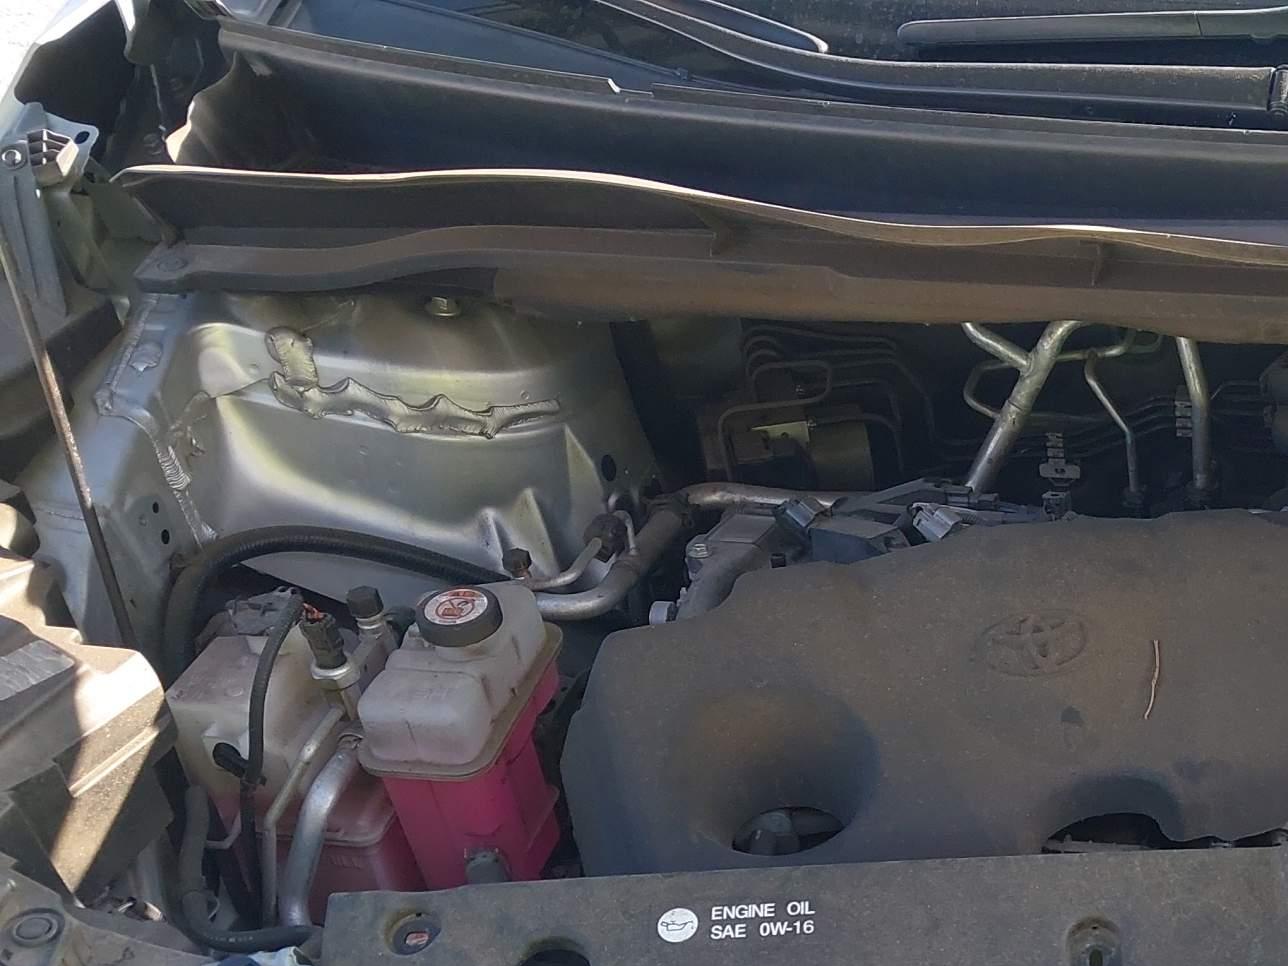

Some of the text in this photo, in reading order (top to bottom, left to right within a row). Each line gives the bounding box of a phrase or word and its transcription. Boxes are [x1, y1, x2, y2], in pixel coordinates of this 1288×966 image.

[711, 901, 815, 920] ENGINE OIL
[711, 920, 815, 939] SAE 0W-16
